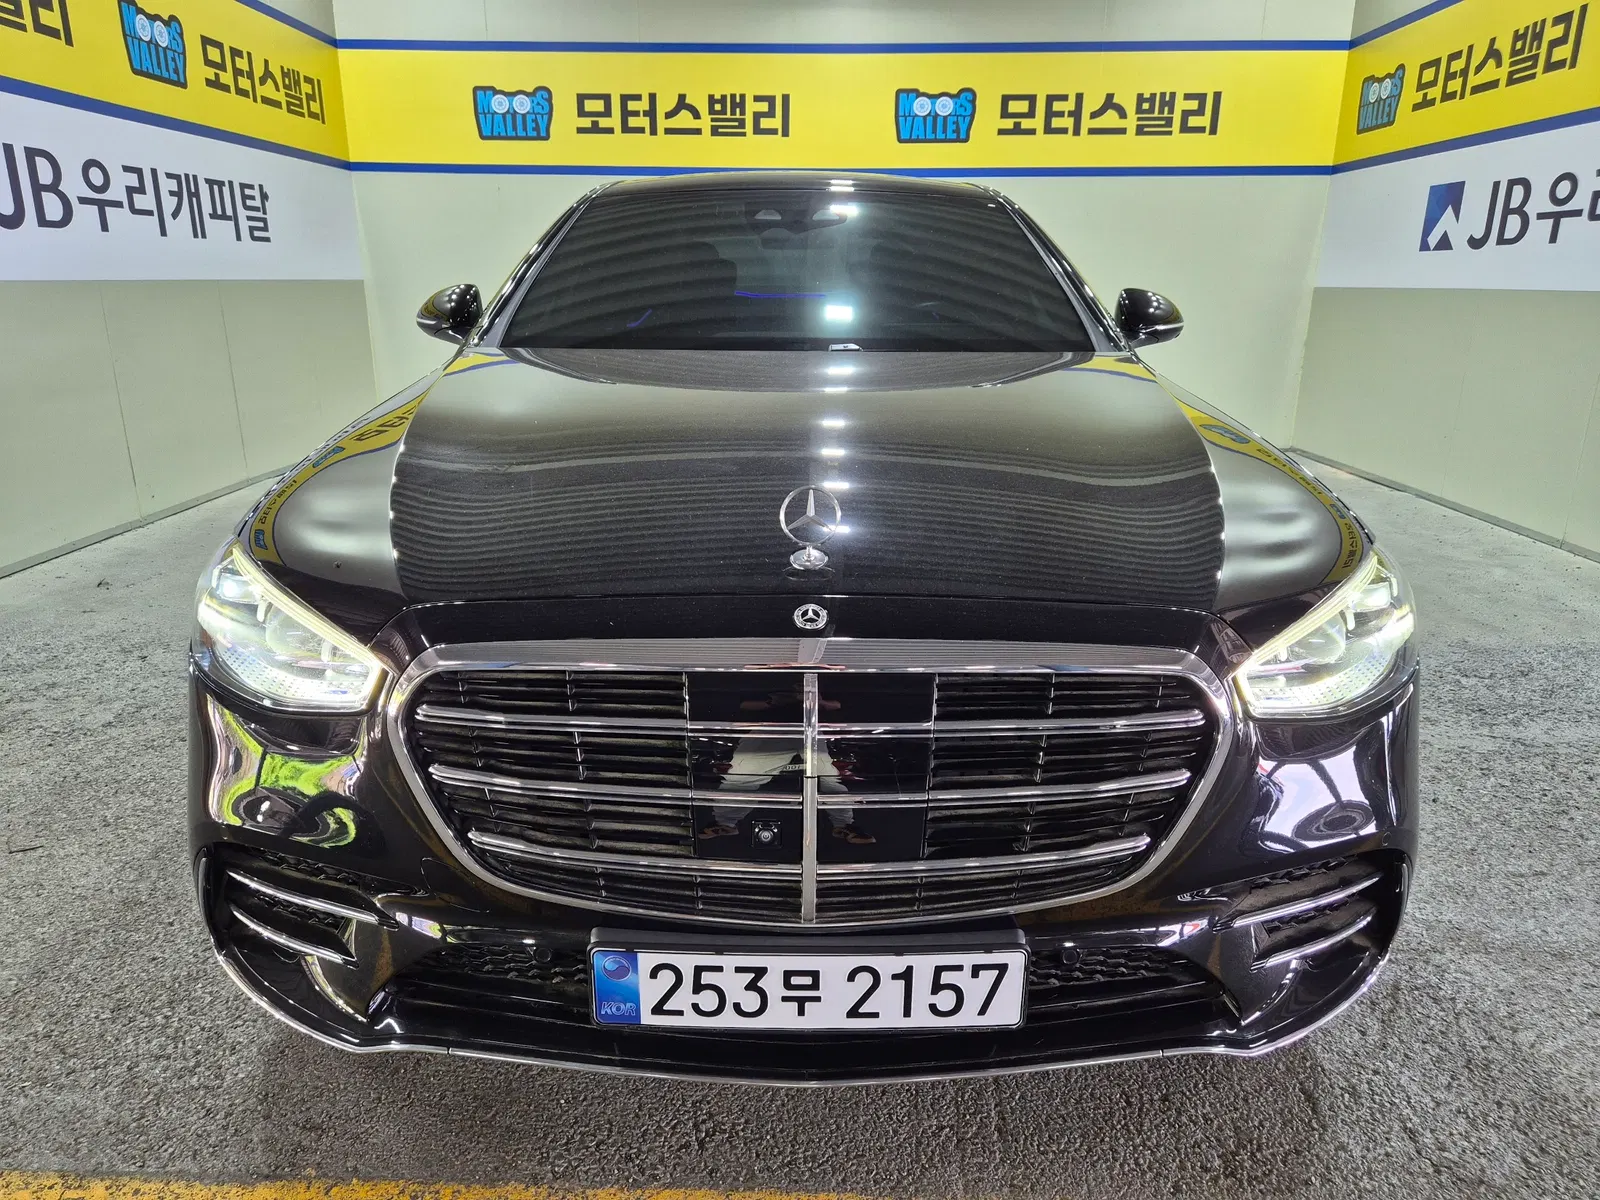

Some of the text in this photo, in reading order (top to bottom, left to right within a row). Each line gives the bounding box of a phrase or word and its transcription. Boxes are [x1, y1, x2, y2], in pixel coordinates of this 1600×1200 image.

[127, 36, 186, 83] VALLEY
[200, 33, 326, 125] 모터스밸리
[1411, 3, 1589, 113] 모터스밸리
[478, 113, 549, 137] VALLEY
[575, 92, 791, 138] 모터스밸리
[899, 115, 971, 140] VALLEY
[996, 91, 1223, 137] 모터스밸리
[1359, 96, 1397, 130] VALLEY
[0, 142, 271, 243] JB우리캐피탈
[601, 1001, 636, 1016] KOR
[648, 962, 1009, 1019] 253무 2157
